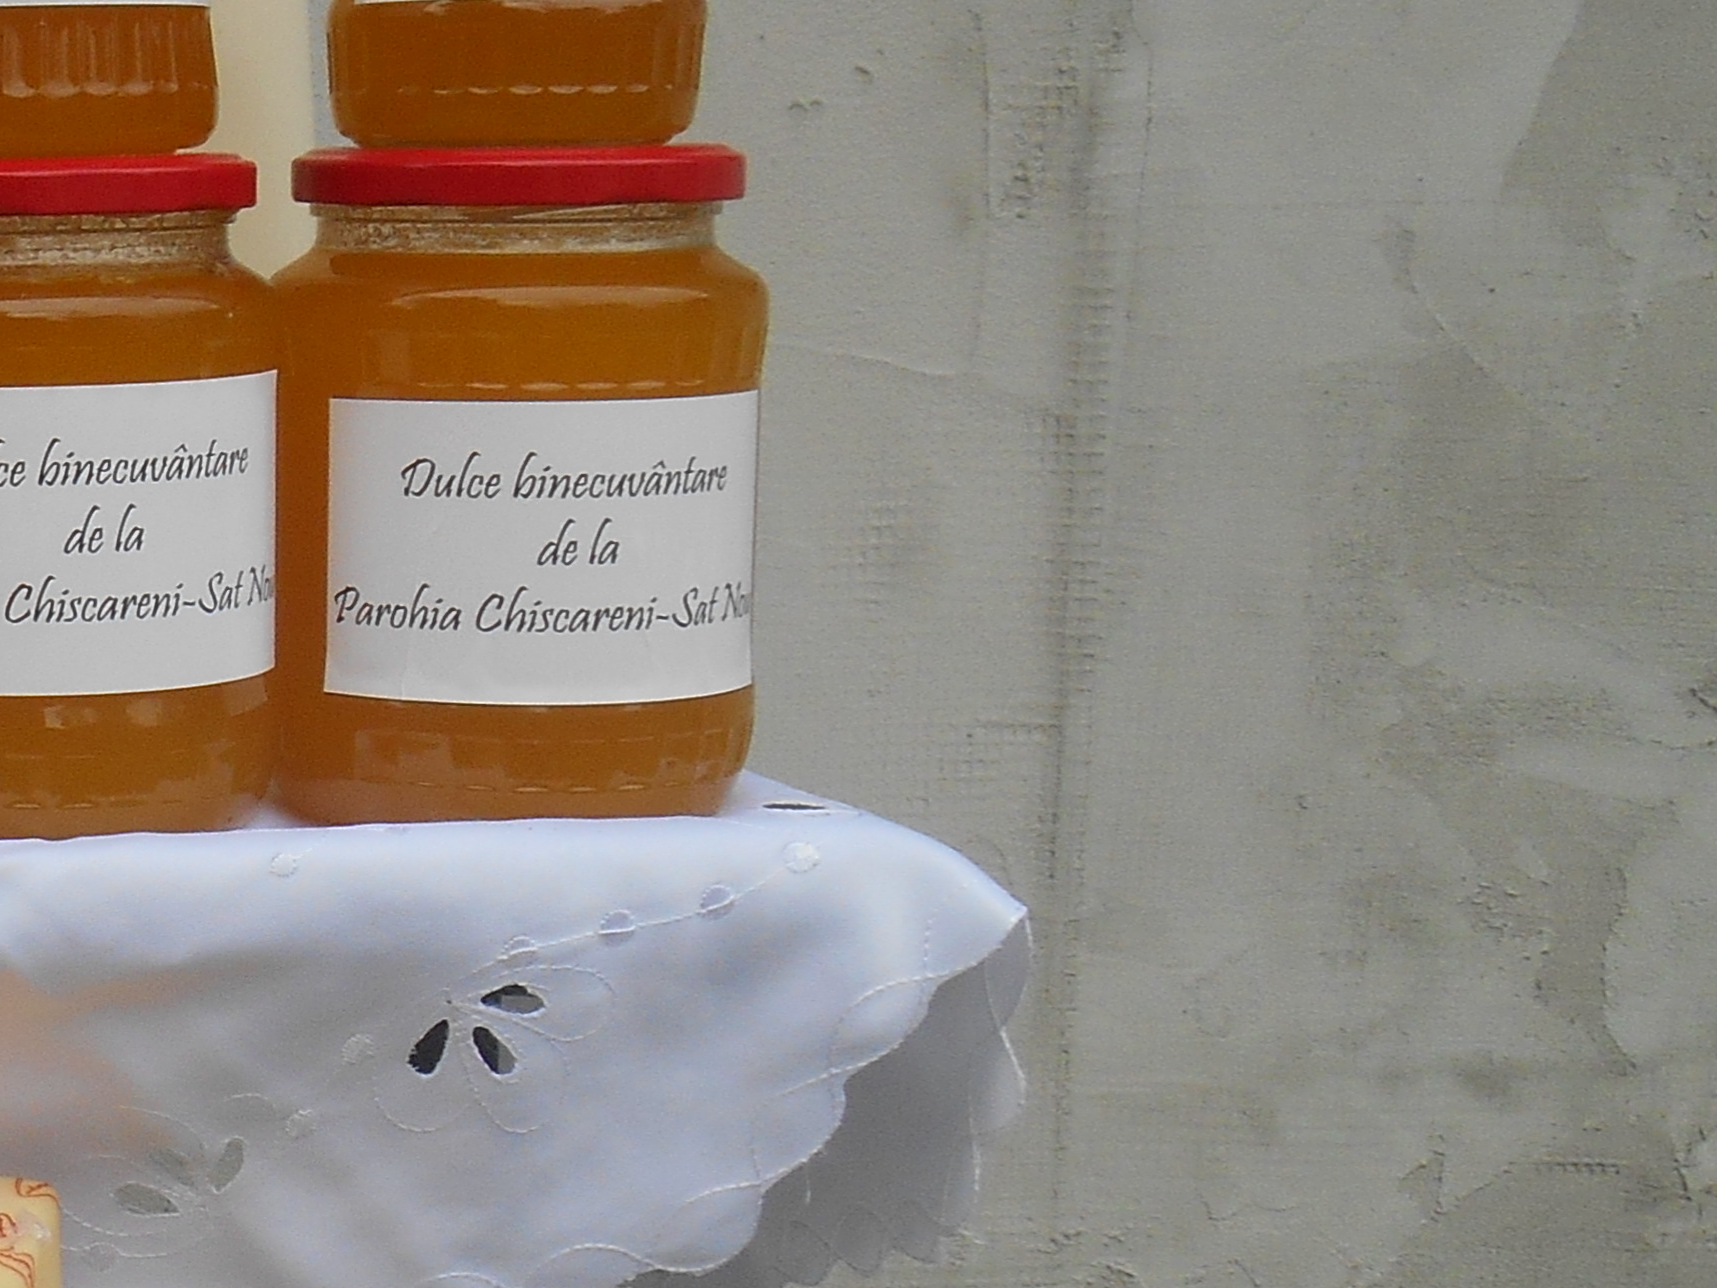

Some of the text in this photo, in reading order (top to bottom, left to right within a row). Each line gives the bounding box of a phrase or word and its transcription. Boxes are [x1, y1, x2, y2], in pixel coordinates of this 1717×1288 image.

[37, 437, 249, 487] binecuvântare
[401, 451, 727, 500] Dulce binecuvântare
[64, 504, 145, 554] de la
[537, 517, 619, 566] de la
[4, 574, 243, 624] Chiscareni-Sat
[334, 584, 718, 634] Parohia Chiscareni-Sat
